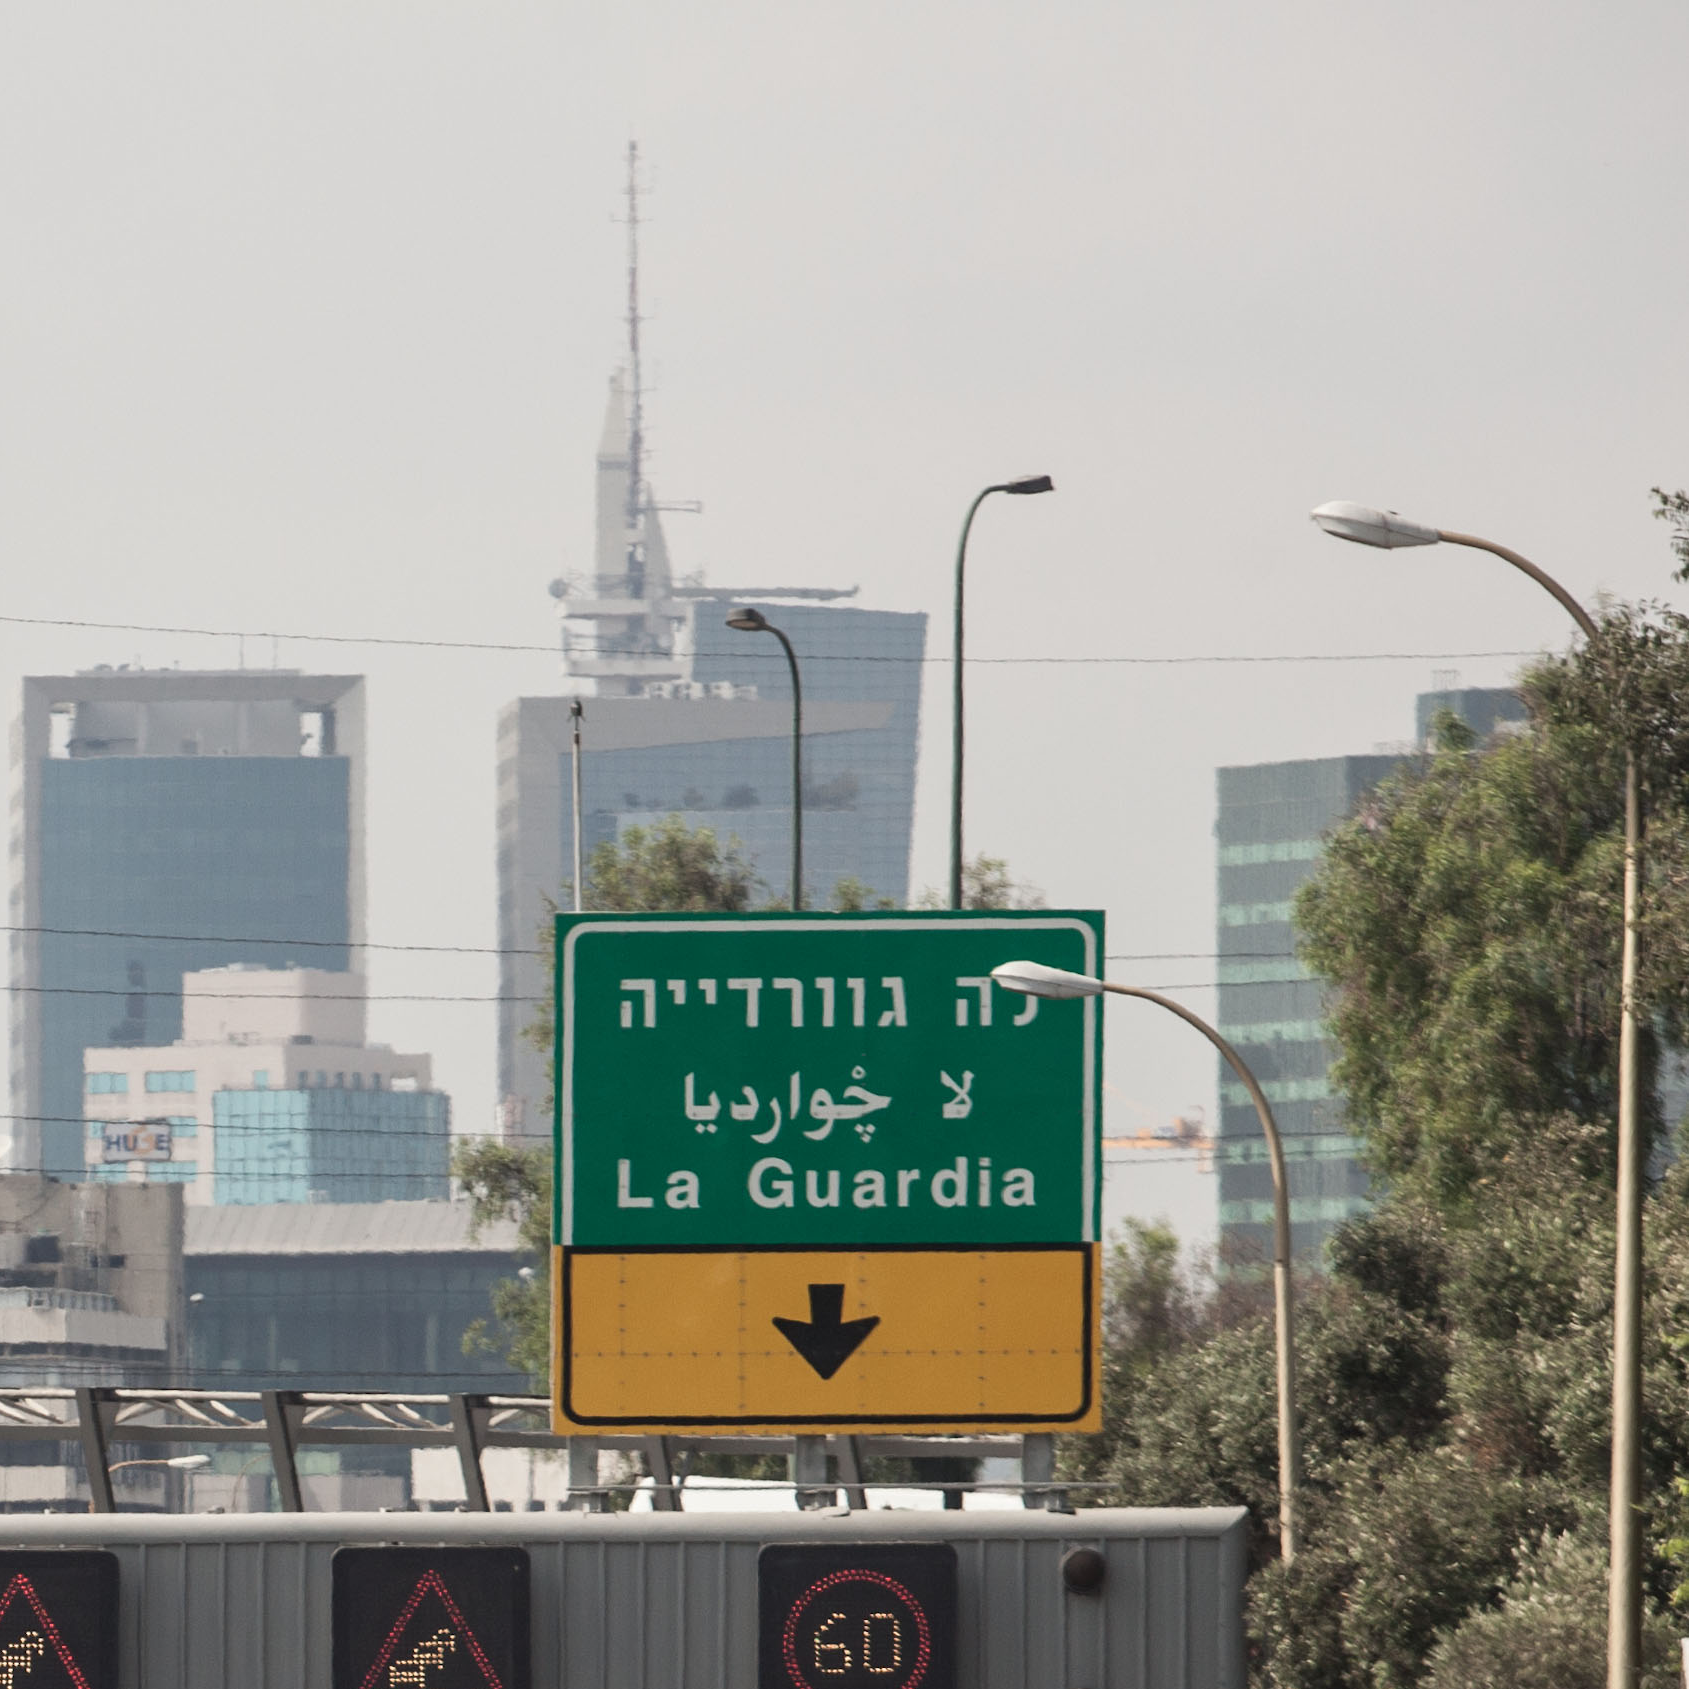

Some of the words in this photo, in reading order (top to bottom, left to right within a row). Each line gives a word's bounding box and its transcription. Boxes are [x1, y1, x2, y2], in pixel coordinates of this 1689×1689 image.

[620, 977, 908, 1028] גוורדייה
[940, 1069, 974, 1119] لا
[617, 1158, 700, 1208] La
[747, 1156, 1036, 1209] Guardia
[813, 1612, 902, 1673] 60
